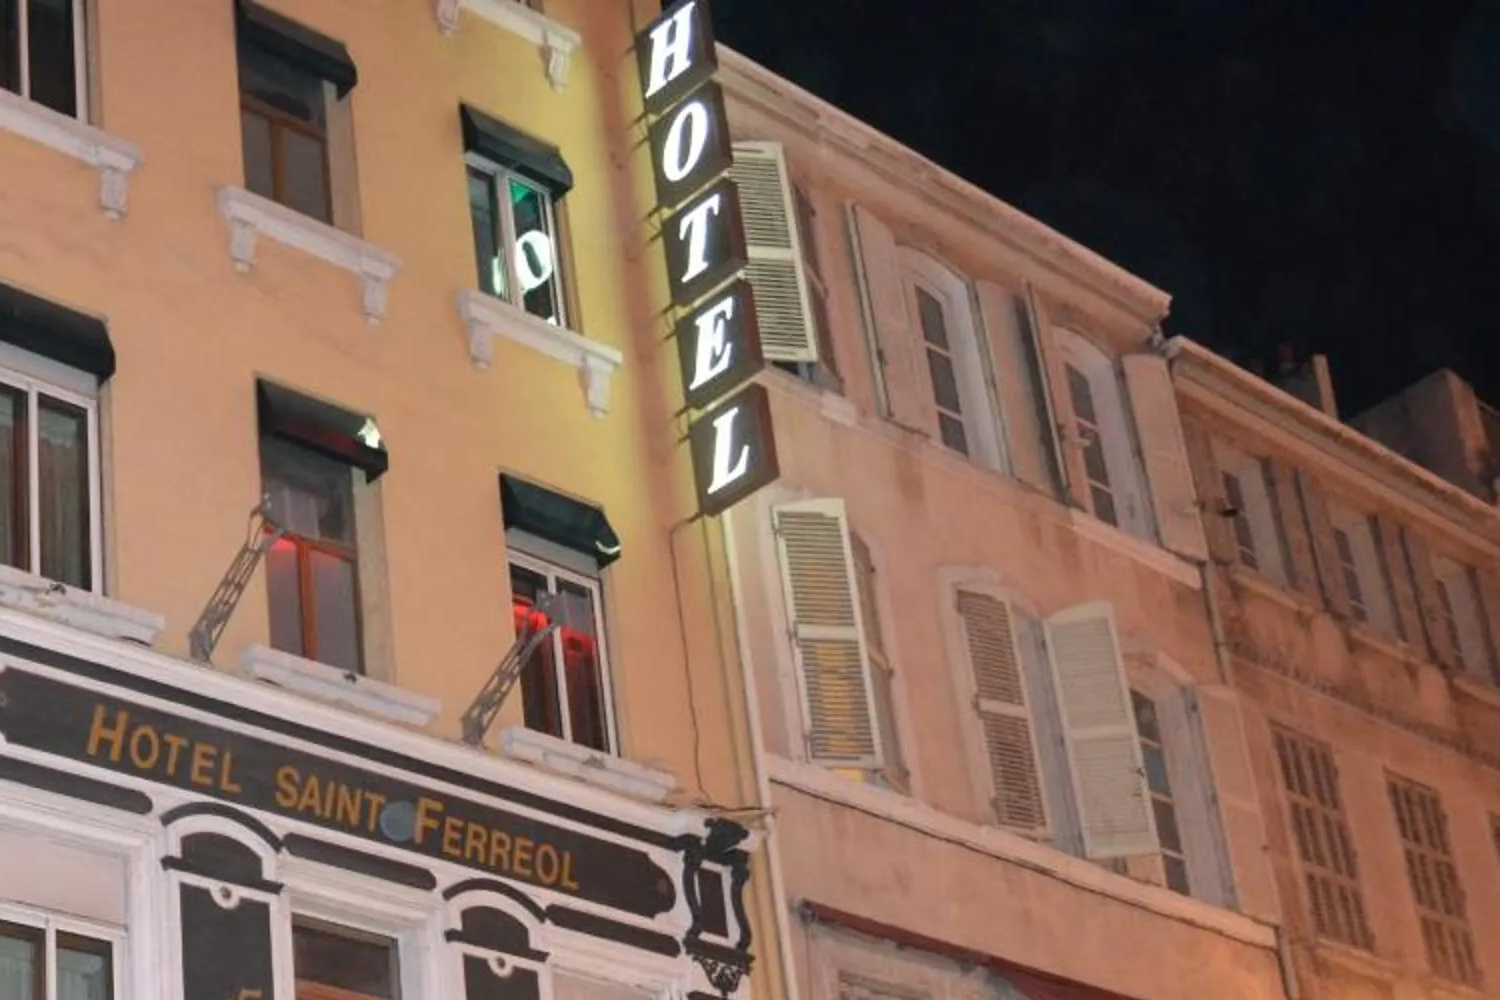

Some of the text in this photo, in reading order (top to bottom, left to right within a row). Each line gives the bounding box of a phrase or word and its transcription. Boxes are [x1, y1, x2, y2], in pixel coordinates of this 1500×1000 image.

[645, 0, 750, 495] HOTEL
[86, 703, 580, 891] HOTEL SAINT FERREOL
